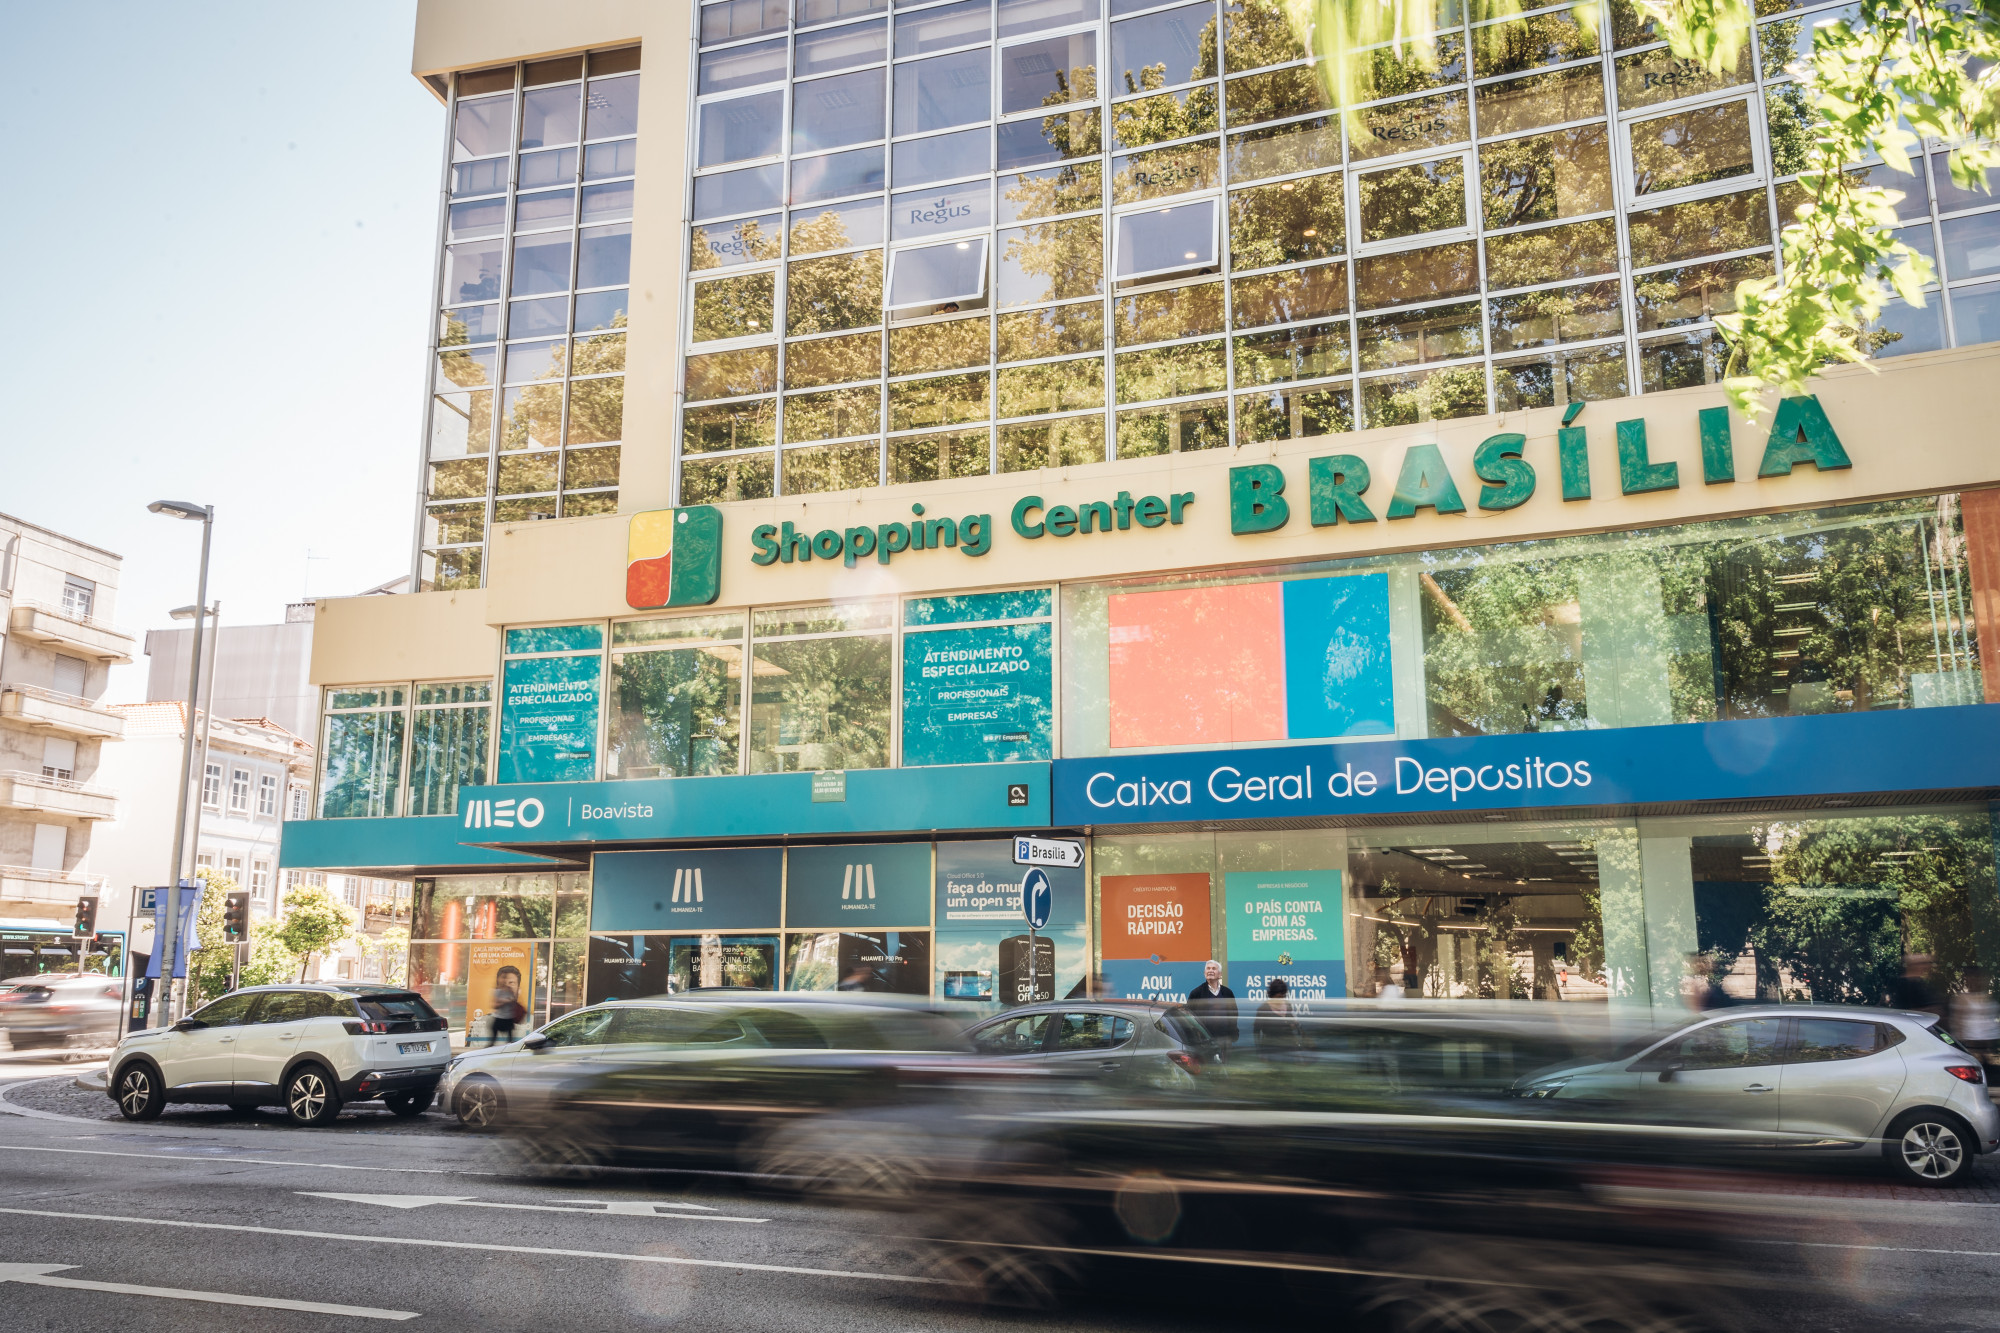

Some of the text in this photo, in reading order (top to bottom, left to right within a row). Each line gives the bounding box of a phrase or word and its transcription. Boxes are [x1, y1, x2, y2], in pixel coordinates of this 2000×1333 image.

[1372, 117, 1446, 141] Regus
[1135, 165, 1200, 187] Regus
[910, 202, 971, 225] Regus
[710, 234, 765, 256] Regus
[750, 393, 1854, 569] Shopping Center BRASÍLIA
[923, 646, 1023, 664] ATENDIMENTO
[922, 659, 1030, 678] ESPECIALIZADO
[510, 680, 588, 694] ATENDIMENTO
[937, 688, 1009, 700] PROFISSIONAIS
[508, 692, 593, 706] ESPECIALIZADO
[519, 714, 575, 724] PROFISSIONAIS
[947, 710, 999, 722] EMPRESAS
[528, 733, 568, 742] EMPRESAS
[1085, 756, 1593, 808] Caixa Geral de Depositos
[464, 797, 654, 829] MEO Boavista
[1032, 845, 1066, 861] Brasília
[947, 881, 974, 898] faça
[976, 881, 994, 894] do
[947, 897, 968, 908] um
[970, 897, 1003, 911] open
[1127, 901, 1184, 919] DECISÃO
[1245, 899, 1323, 914] O PAÍS CONTA
[1127, 918, 1184, 935] RÁPIDA?
[1262, 914, 1307, 927] COM AS
[1252, 928, 1318, 941] EMPRESAS.
[743, 956, 753, 964] DE
[1141, 975, 1172, 990] AQUI
[1245, 975, 1262, 988] AS
[1299, 988, 1326, 1002] COM
